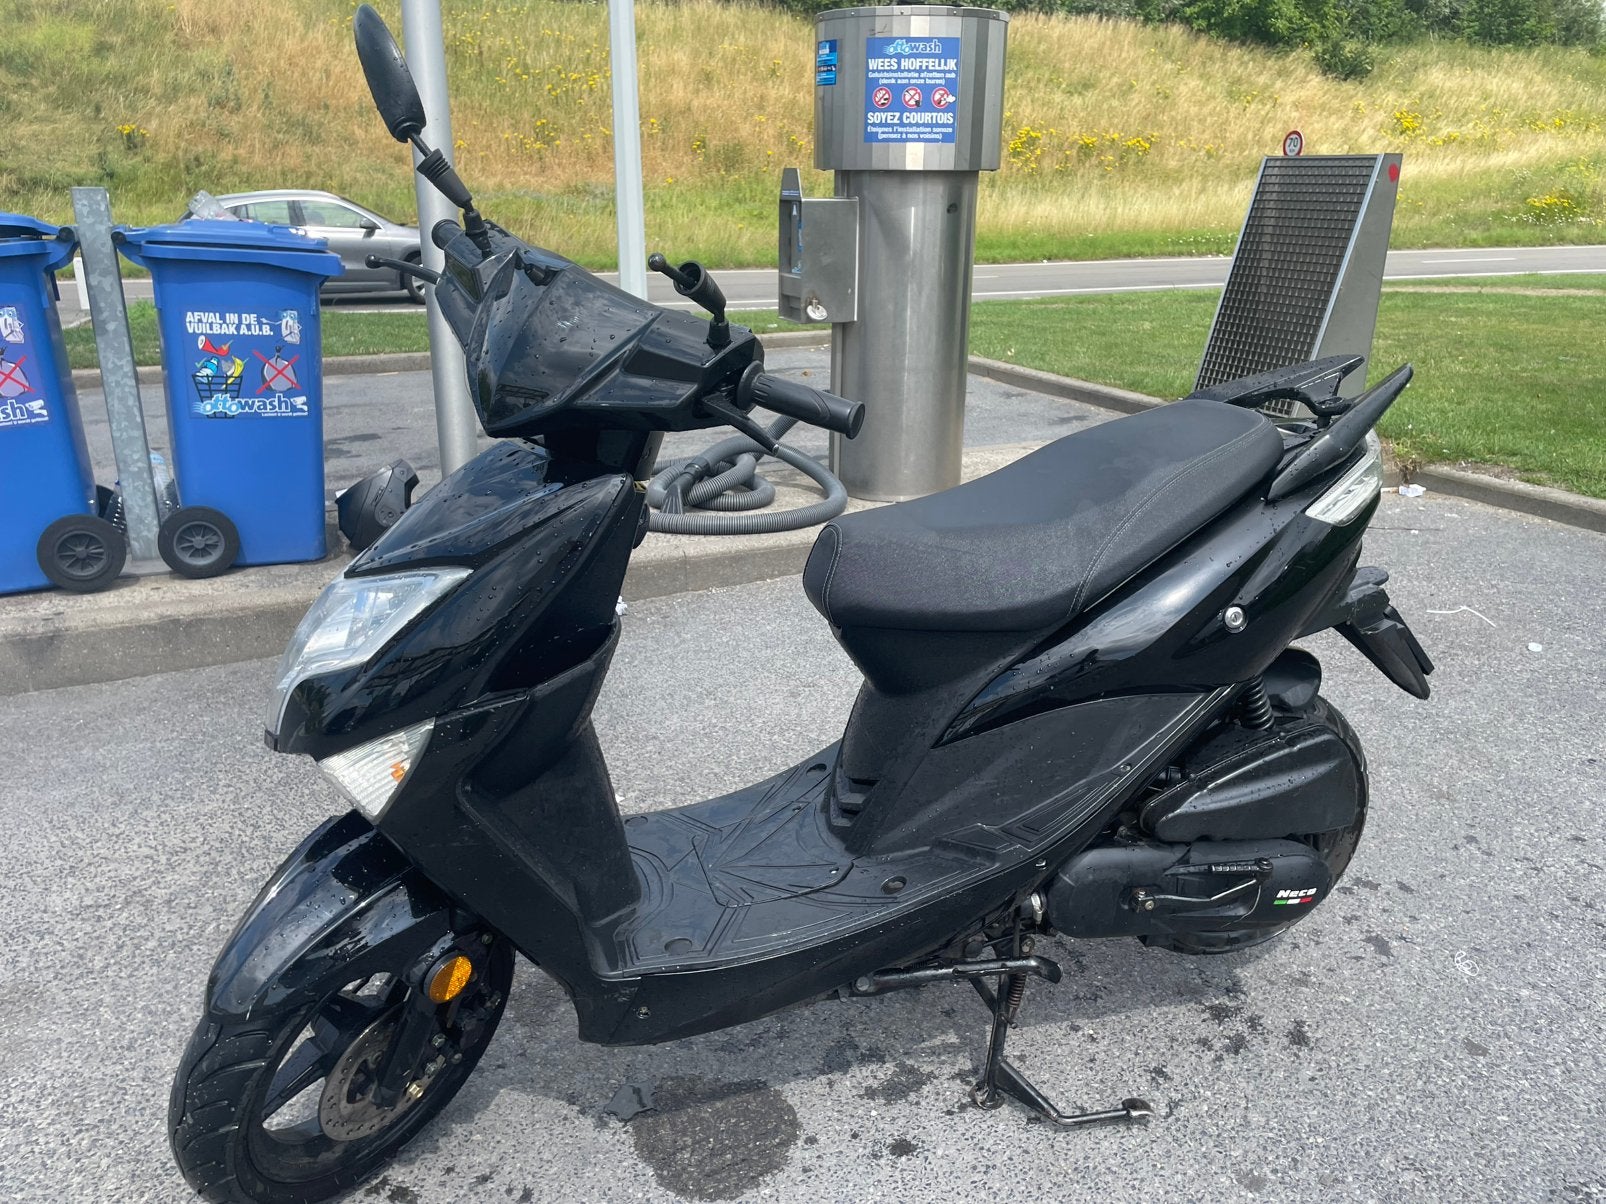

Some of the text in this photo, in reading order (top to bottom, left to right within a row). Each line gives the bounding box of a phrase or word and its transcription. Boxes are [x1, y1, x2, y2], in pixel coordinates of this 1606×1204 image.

[868, 58, 957, 71] WEES HOFFELIJK
[867, 112, 954, 124] SOYEZ COURTOIS
[1288, 137, 1298, 147] 70
[186, 311, 257, 325] AFVAL IN DE
[186, 323, 274, 336] VUILBAK A.U.B.
[200, 393, 291, 415] ottowash
[1276, 887, 1317, 898] Neco
